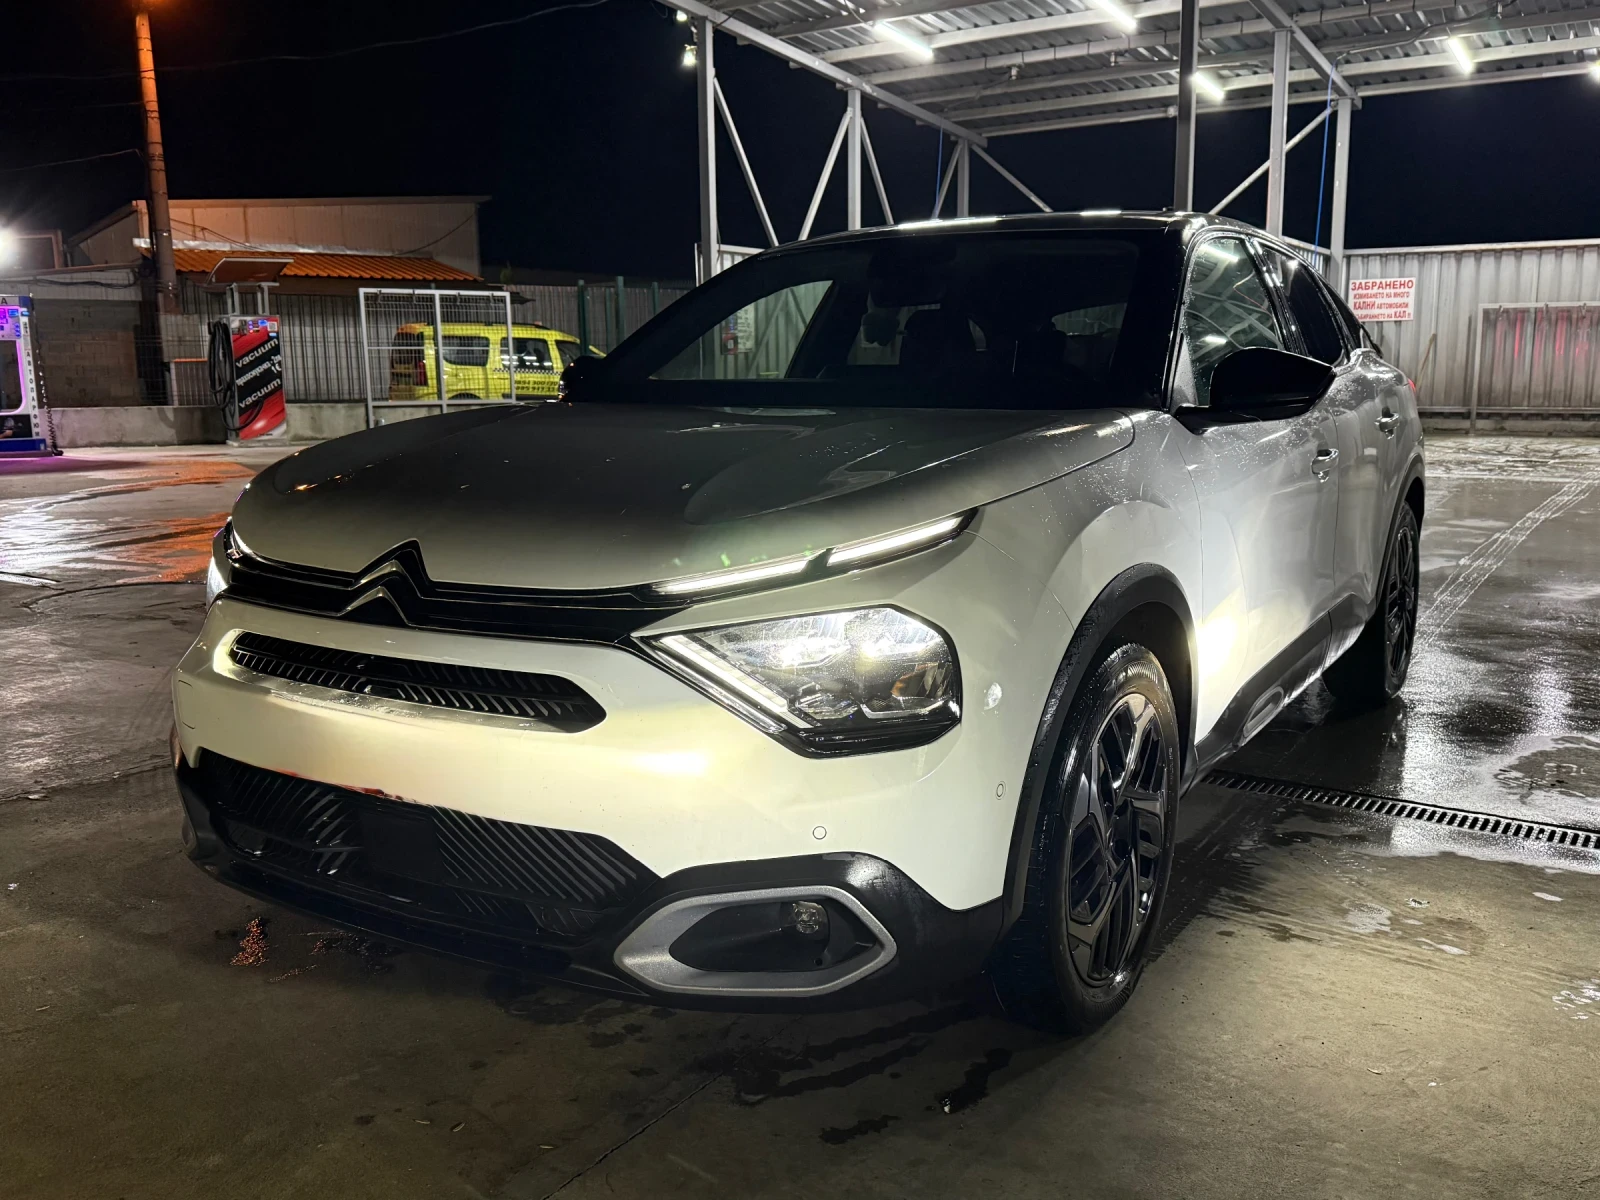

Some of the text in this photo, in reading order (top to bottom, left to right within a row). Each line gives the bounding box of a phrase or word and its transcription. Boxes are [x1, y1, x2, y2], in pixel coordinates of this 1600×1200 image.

[1351, 280, 1414, 291] ЗАБРАНЕНО
[1353, 292, 1384, 300] ИЗМИВАНЕТО
[1353, 300, 1376, 310] КАЛНИ
[1394, 310, 1407, 319] КАЛ
[235, 338, 279, 368] vacuum
[26, 351, 40, 437] АВТОПАРФЮМ
[239, 378, 282, 409] vacuum
